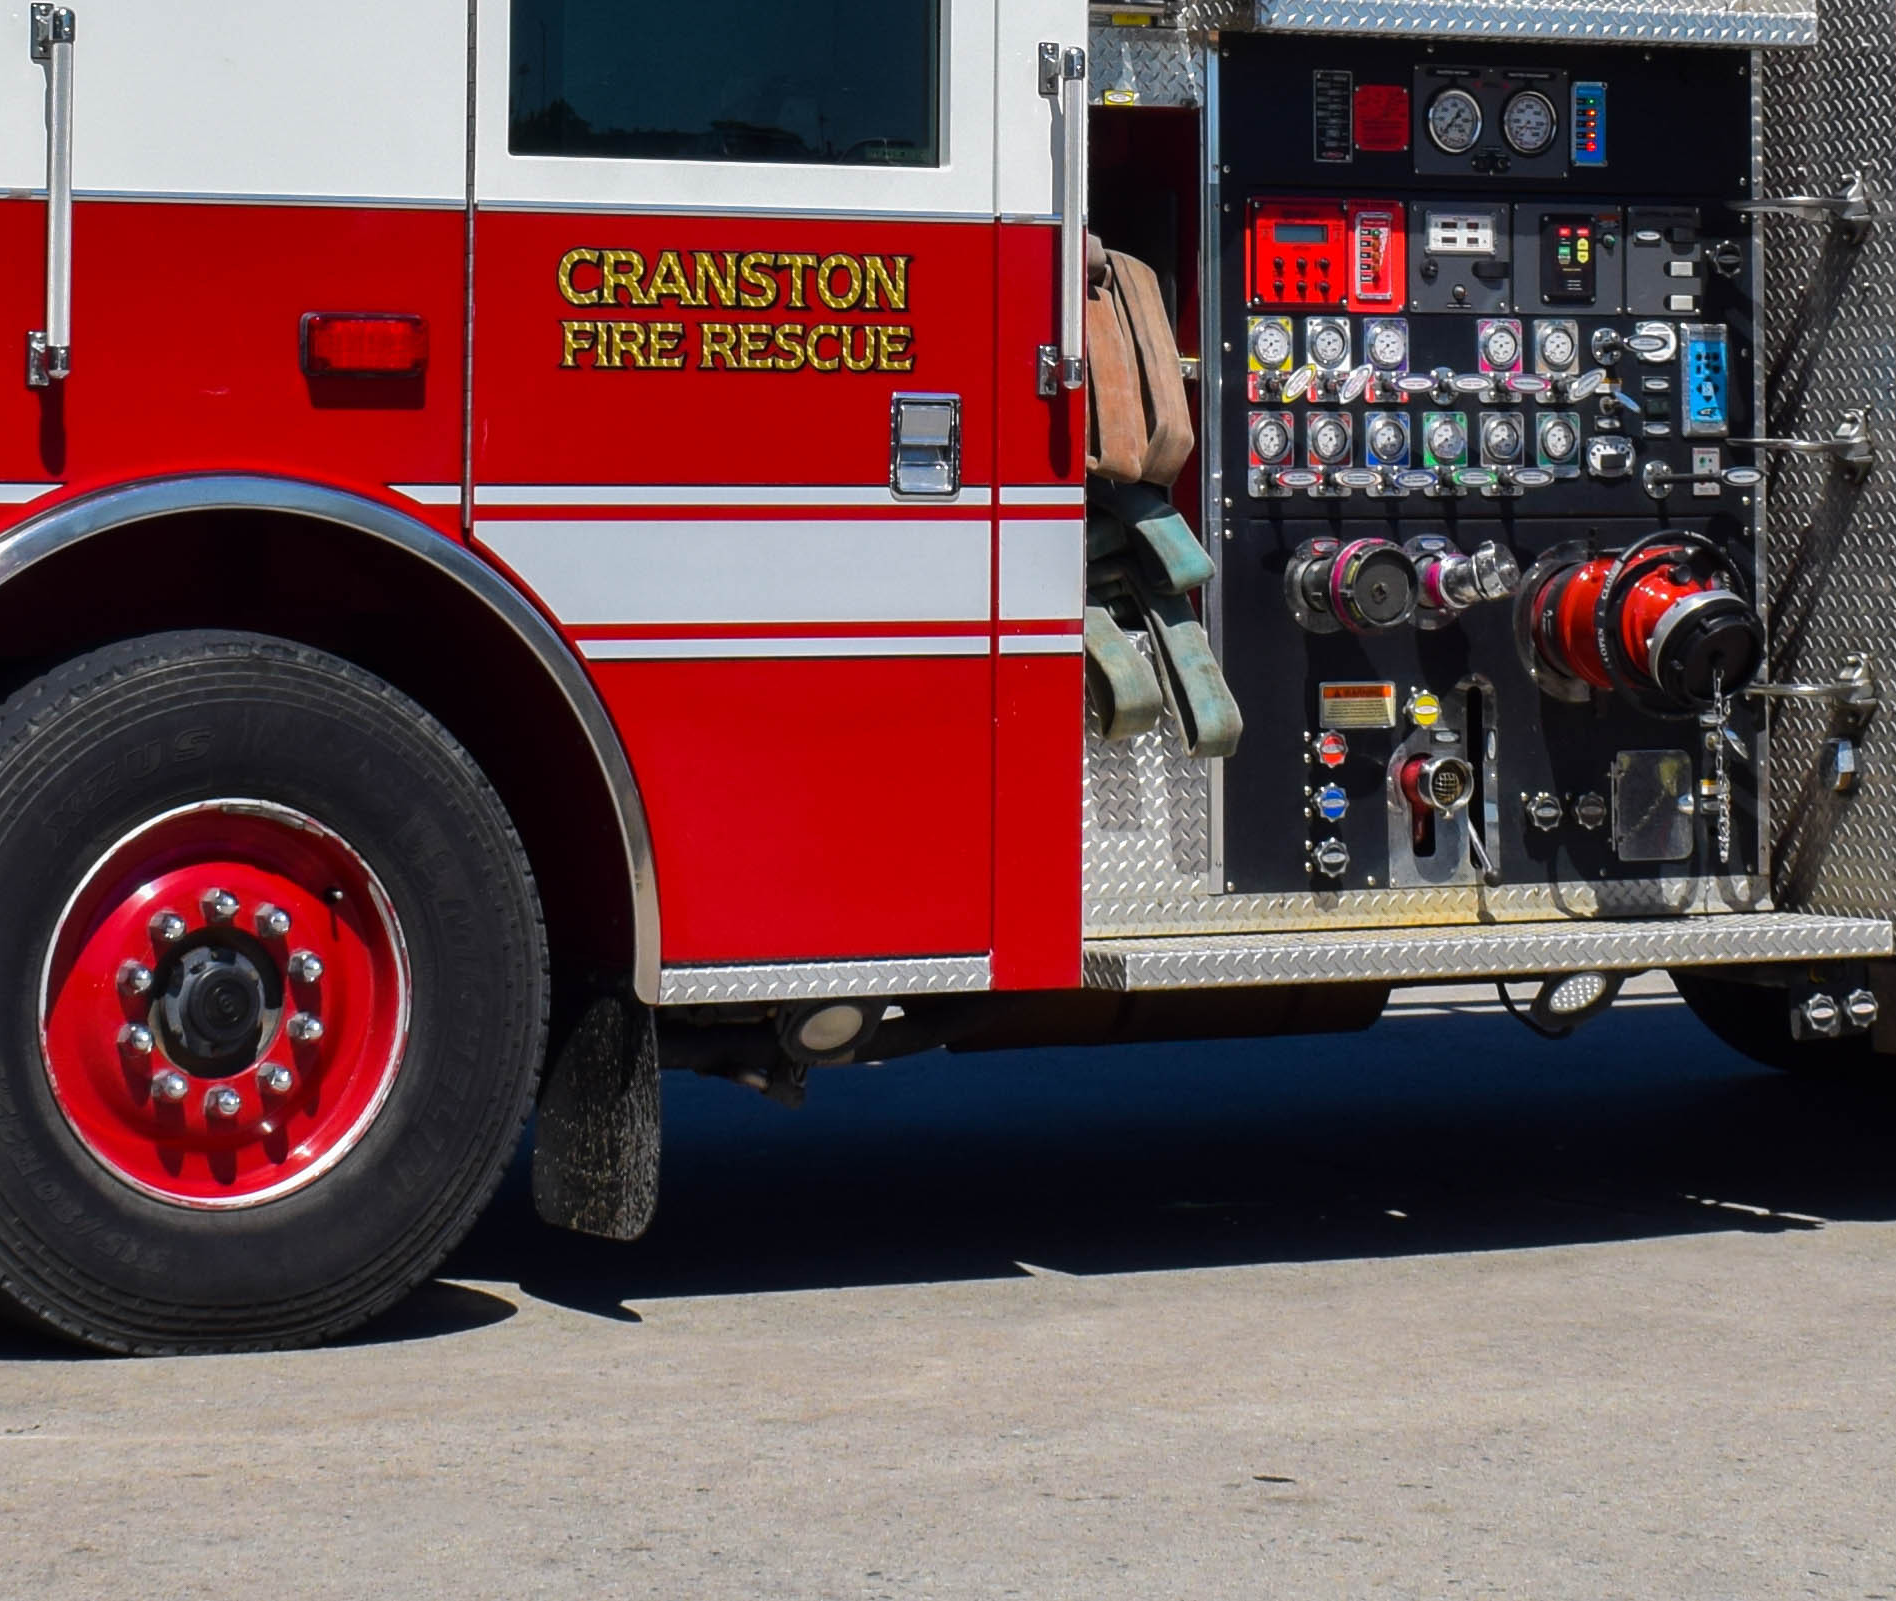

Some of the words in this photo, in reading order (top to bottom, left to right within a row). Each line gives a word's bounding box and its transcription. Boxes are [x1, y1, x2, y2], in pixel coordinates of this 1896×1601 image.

[557, 247, 915, 312] CRANSTON
[559, 319, 688, 371] FIRE
[698, 321, 916, 376] RESCUE
